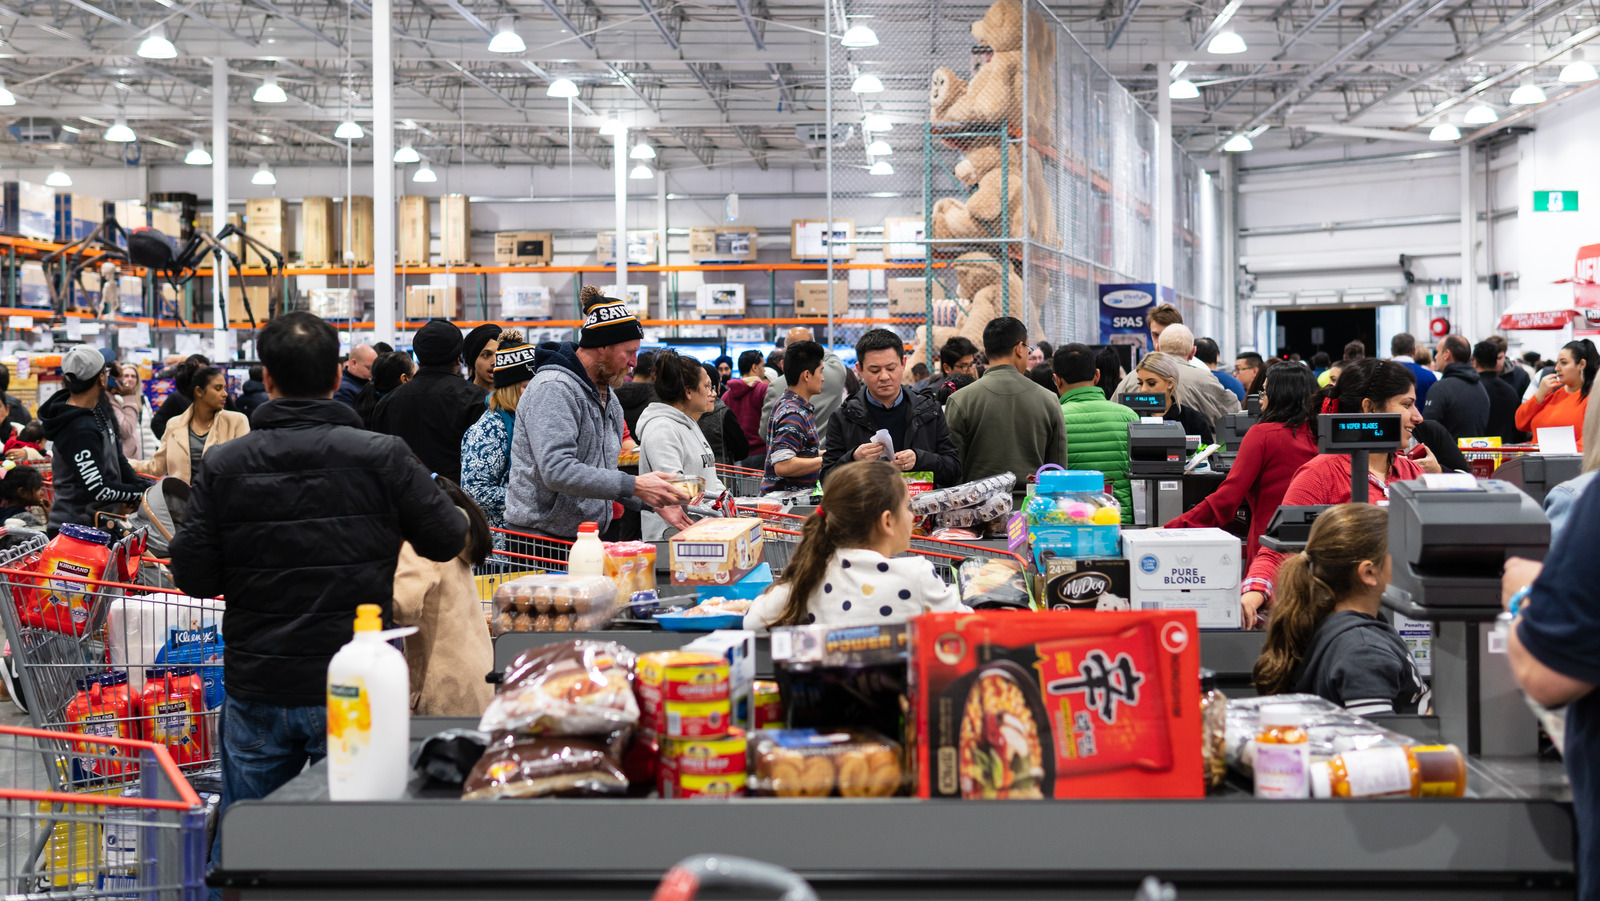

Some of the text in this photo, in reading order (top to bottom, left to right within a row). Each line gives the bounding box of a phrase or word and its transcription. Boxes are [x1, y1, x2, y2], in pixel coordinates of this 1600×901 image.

[1113, 316, 1143, 328] SPAS
[1361, 422, 1379, 430] BLADES
[74, 449, 144, 501] SAINT GOLIAT
[58, 562, 91, 574] KIRKLAND
[1171, 568, 1198, 576] PURE
[1164, 576, 1206, 584] BLONDE
[175, 630, 214, 643] Kleenx
[827, 626, 880, 641] ATOMIC
[827, 635, 891, 652] POWER
[1048, 650, 1144, 723] 辛
[99, 725, 118, 733] Clean
